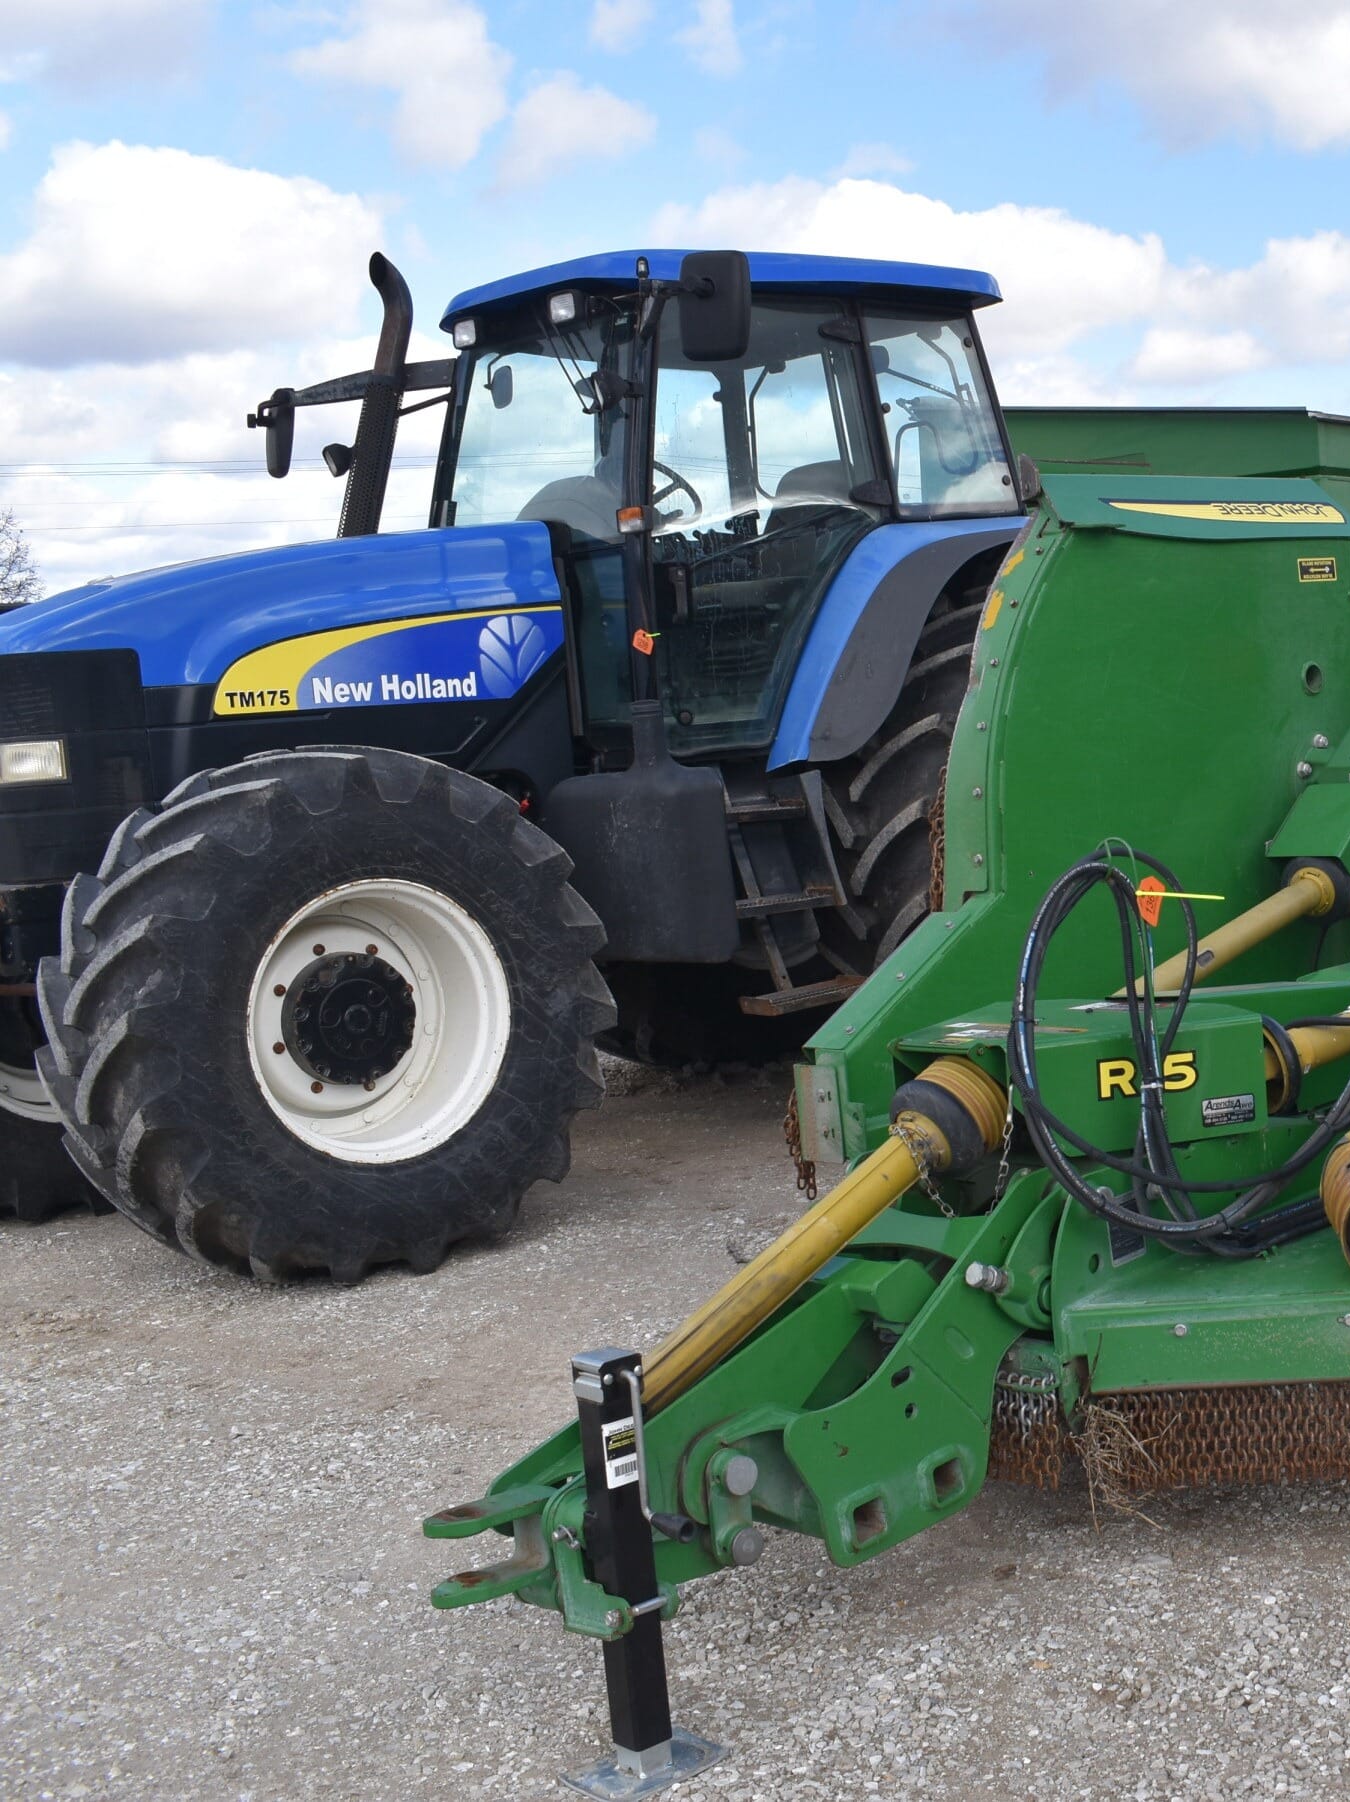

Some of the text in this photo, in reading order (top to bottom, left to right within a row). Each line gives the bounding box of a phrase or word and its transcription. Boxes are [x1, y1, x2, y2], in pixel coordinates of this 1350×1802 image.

[1212, 504, 1329, 518] JOHN DEERE
[225, 690, 291, 709] TM175
[312, 671, 477, 704] New Holland
[1098, 1051, 1197, 1100] R5
